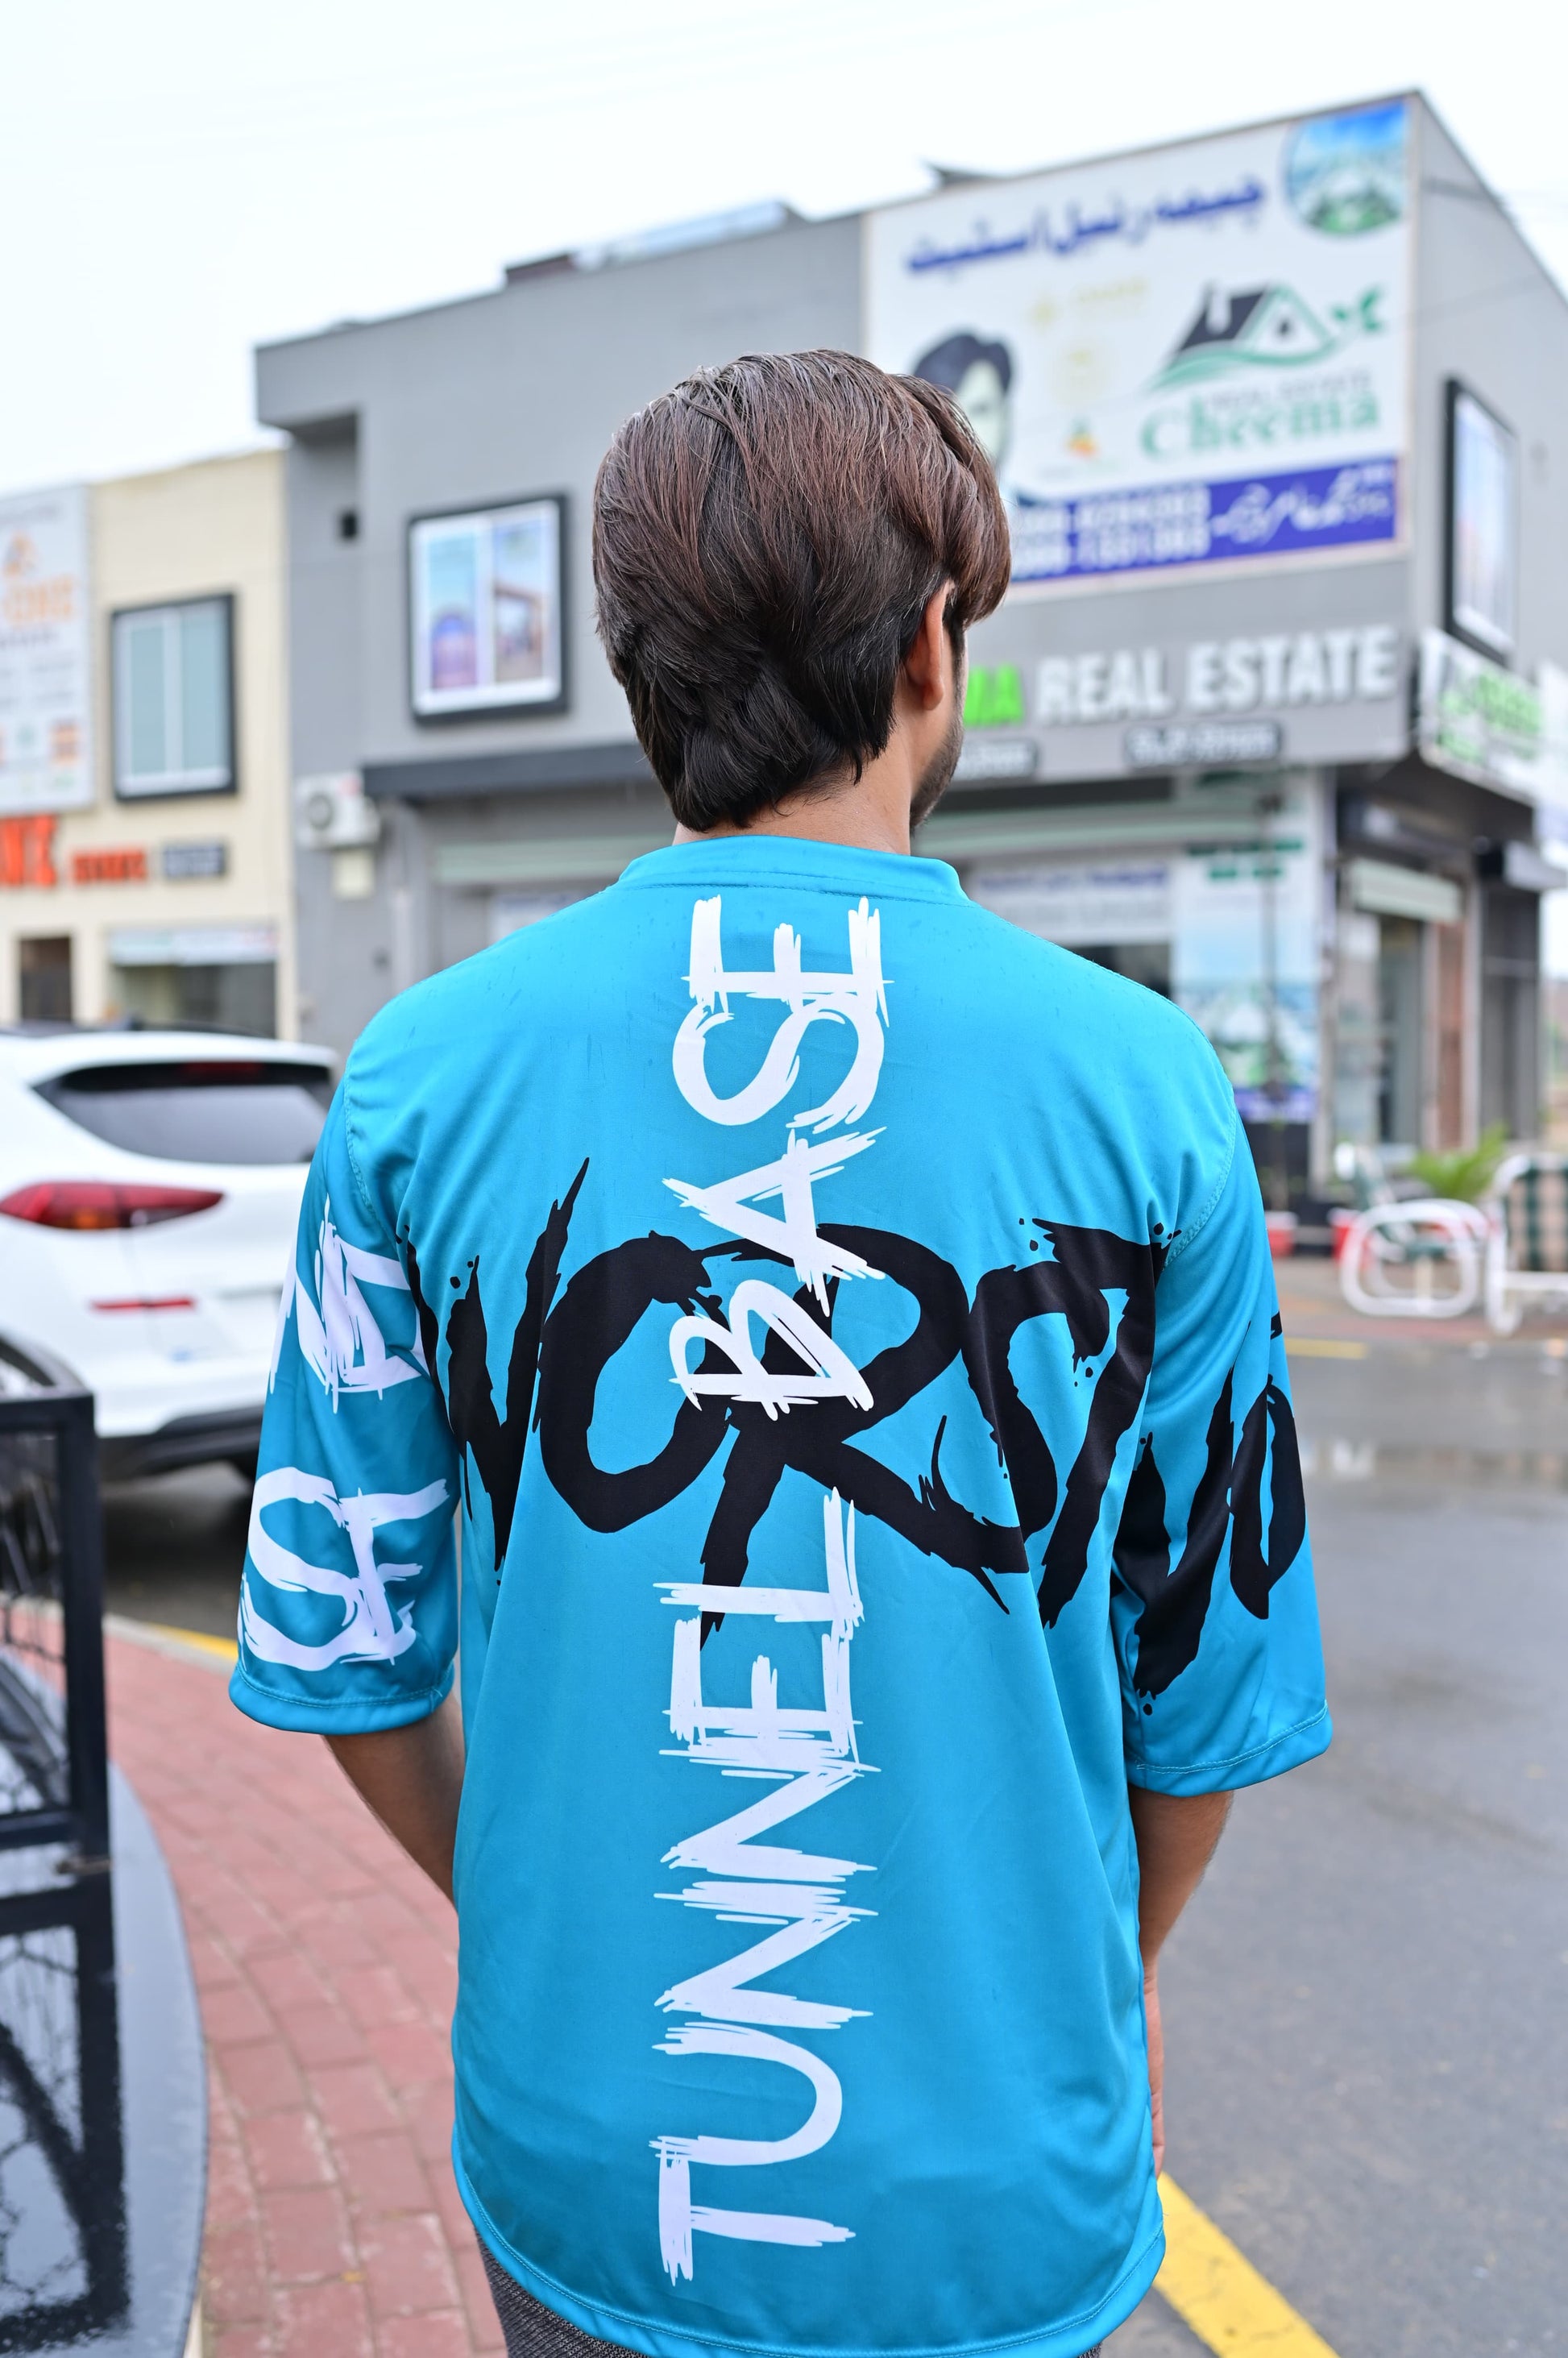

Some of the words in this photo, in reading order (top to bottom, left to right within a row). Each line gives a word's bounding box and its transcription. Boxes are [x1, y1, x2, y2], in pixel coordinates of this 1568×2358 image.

[1138, 392, 1380, 464] Cheema
[1032, 648, 1172, 723] REAL
[1184, 625, 1400, 710] ESTATE
[662, 895, 894, 1422] BASE
[648, 1486, 881, 2286] TUNNEL
